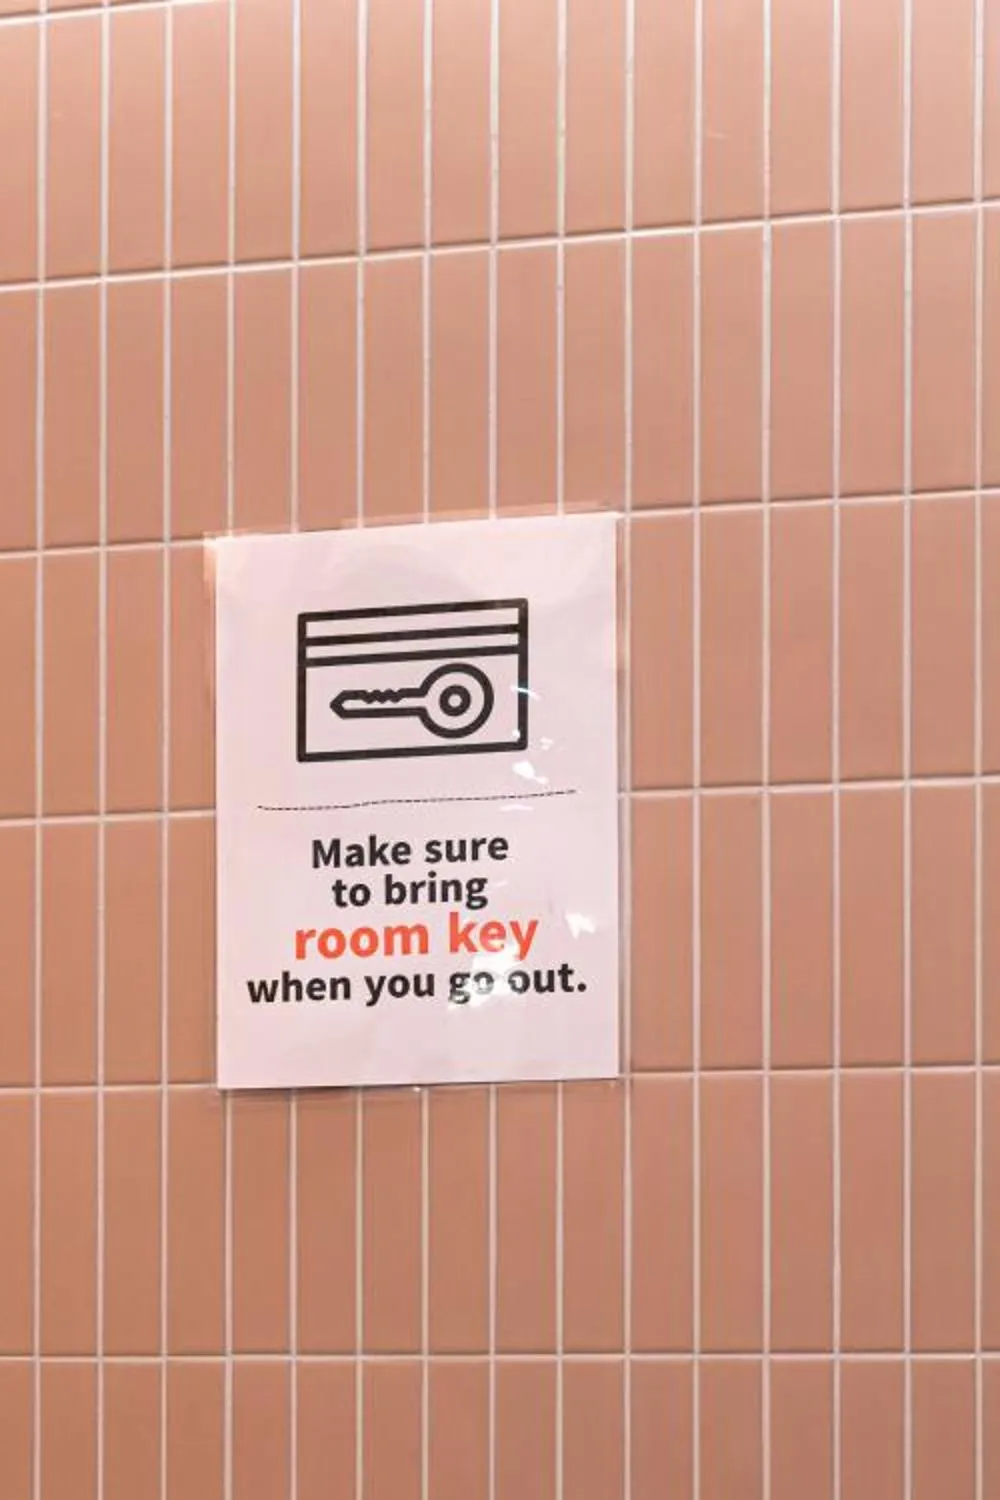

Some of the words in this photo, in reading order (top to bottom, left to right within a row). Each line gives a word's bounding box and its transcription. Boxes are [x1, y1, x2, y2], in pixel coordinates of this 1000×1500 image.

[311, 836, 411, 869] Make
[425, 835, 509, 862] sure
[332, 878, 371, 908] to
[384, 873, 488, 910] bring
[295, 923, 429, 961] room
[449, 912, 538, 960] key
[247, 969, 351, 1004] when
[365, 973, 435, 1007] you
[449, 971, 494, 1005] go
[507, 963, 587, 995] out.
